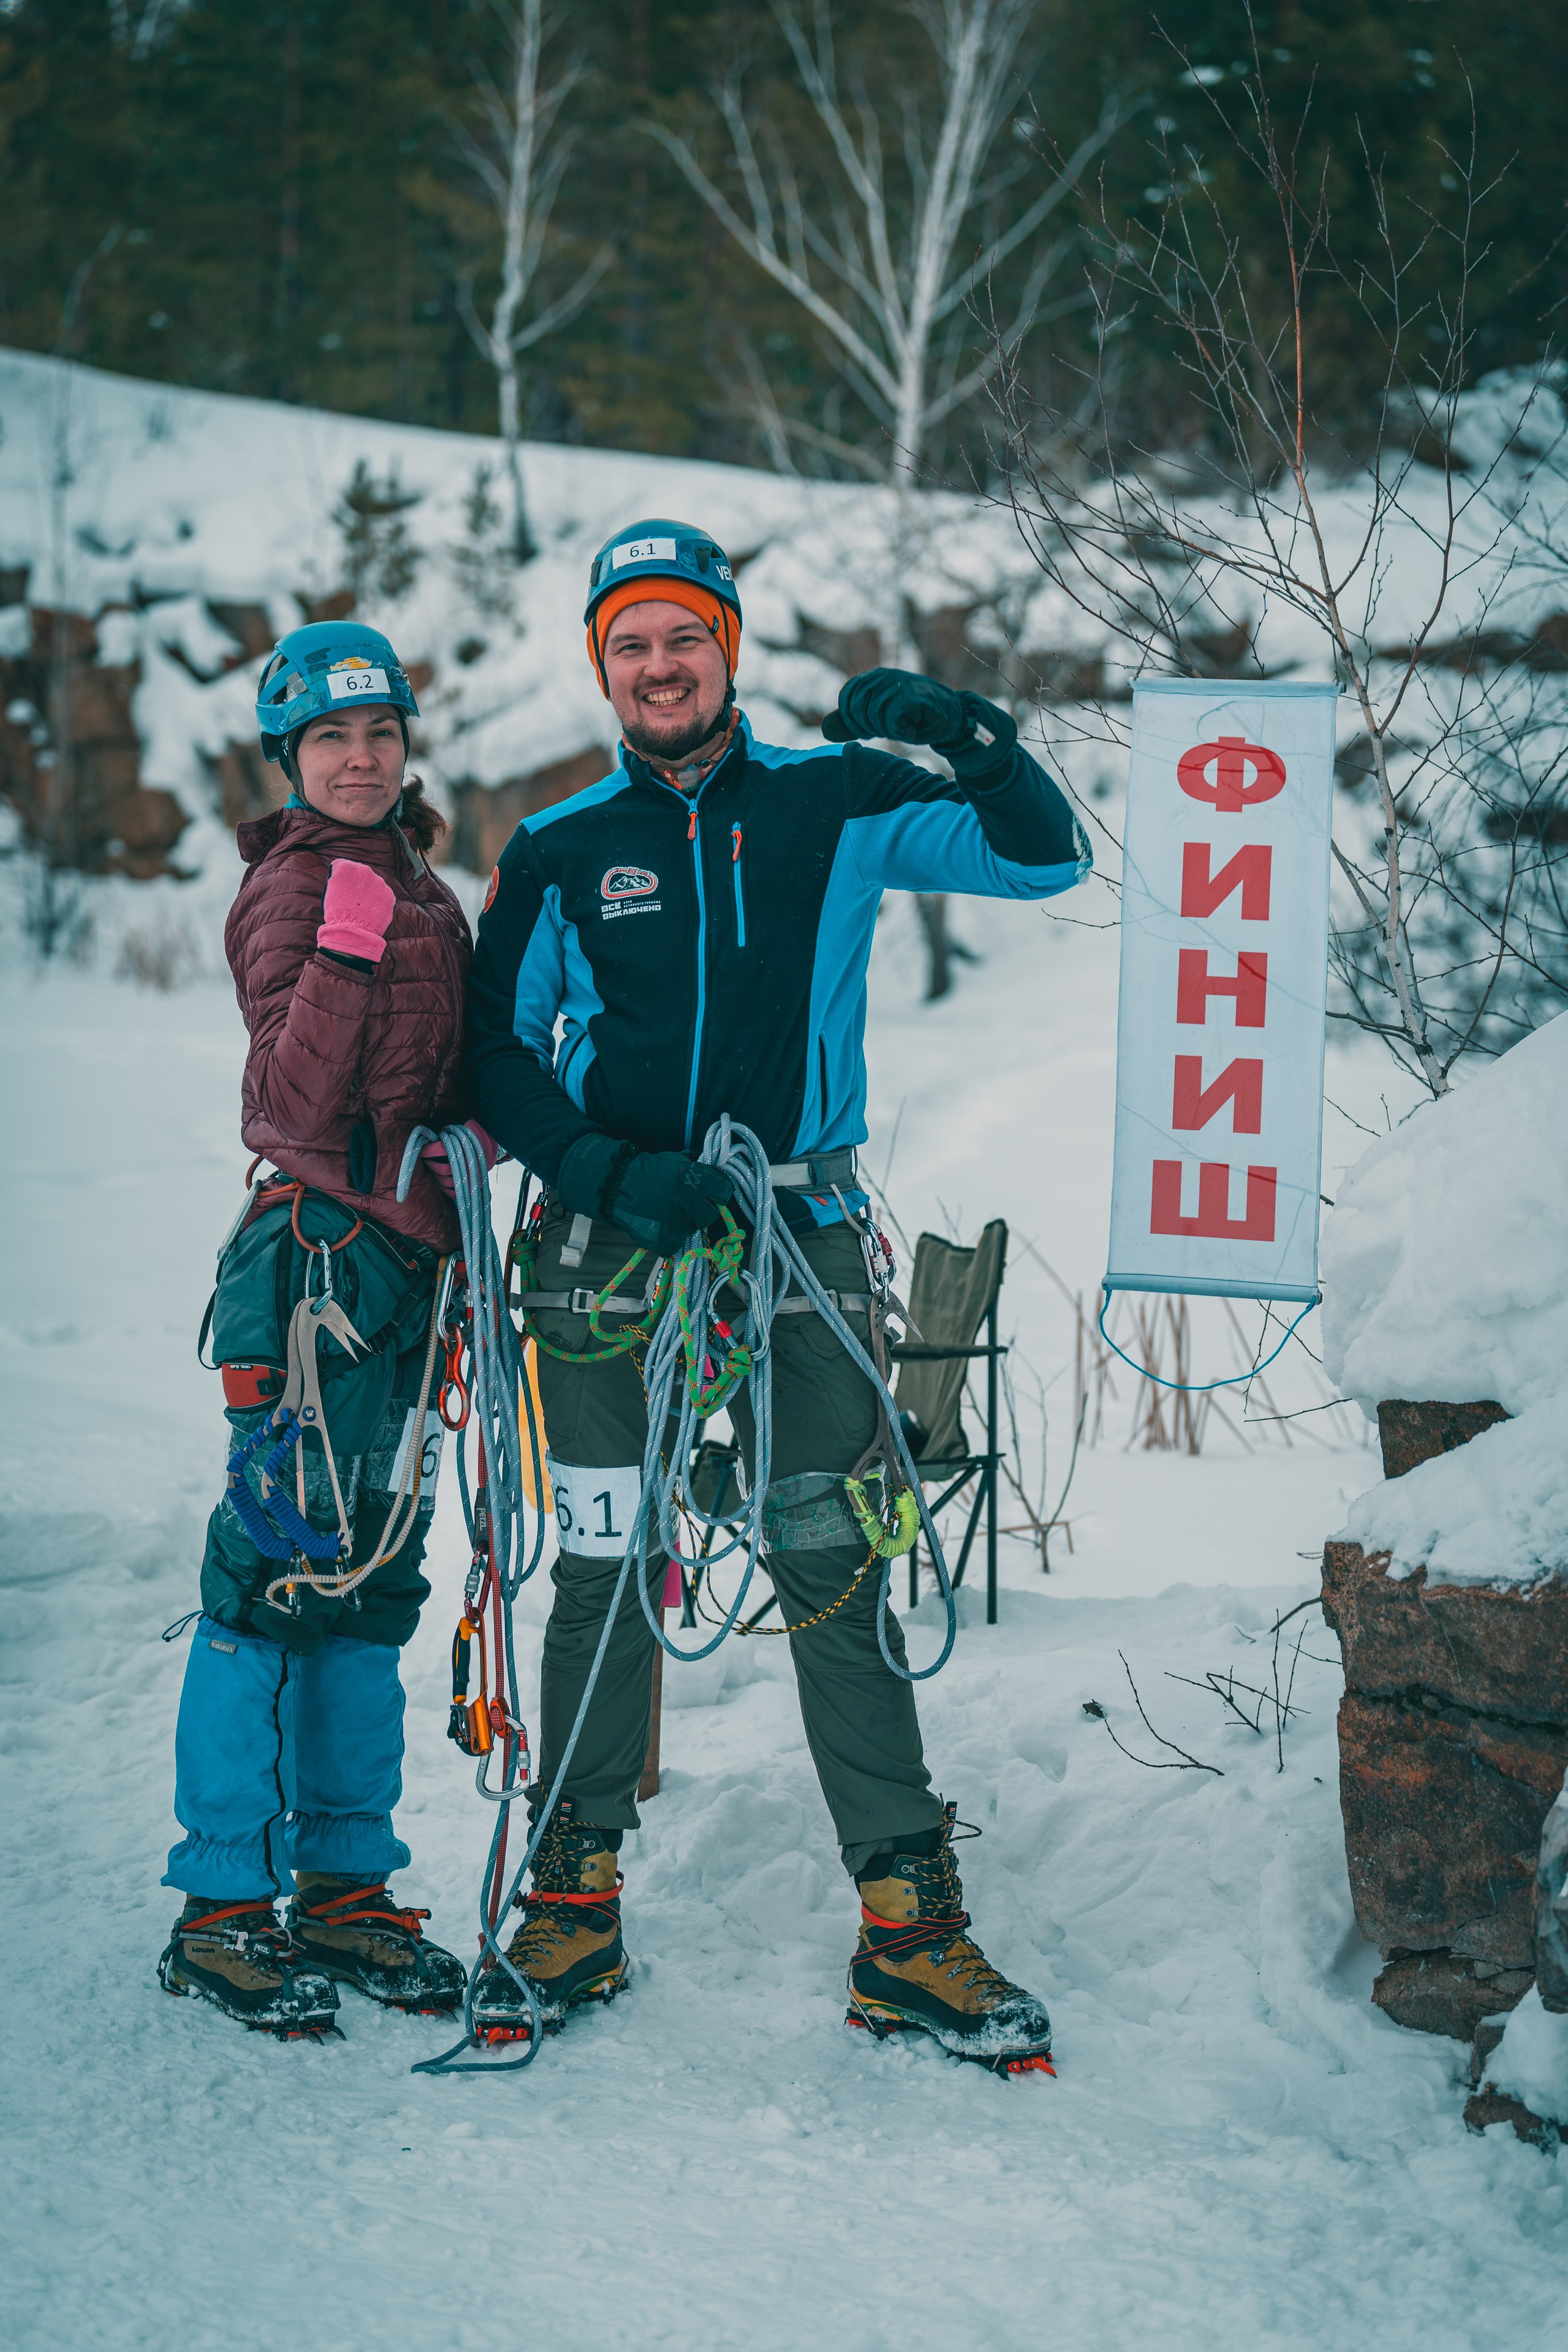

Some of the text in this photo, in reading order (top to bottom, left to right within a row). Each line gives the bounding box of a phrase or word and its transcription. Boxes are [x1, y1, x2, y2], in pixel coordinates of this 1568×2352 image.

[630, 543, 656, 557] 6.1
[346, 675, 374, 690] 6.2
[601, 901, 622, 913] ВСЁ
[602, 904, 662, 921] ВЫКЛЮЧЕНО
[1150, 736, 1287, 1242] ФИНИШ
[476, 1507, 487, 1531] PETZL
[555, 1485, 622, 1537] 6.1
[254, 1944, 270, 1954] PETZL
